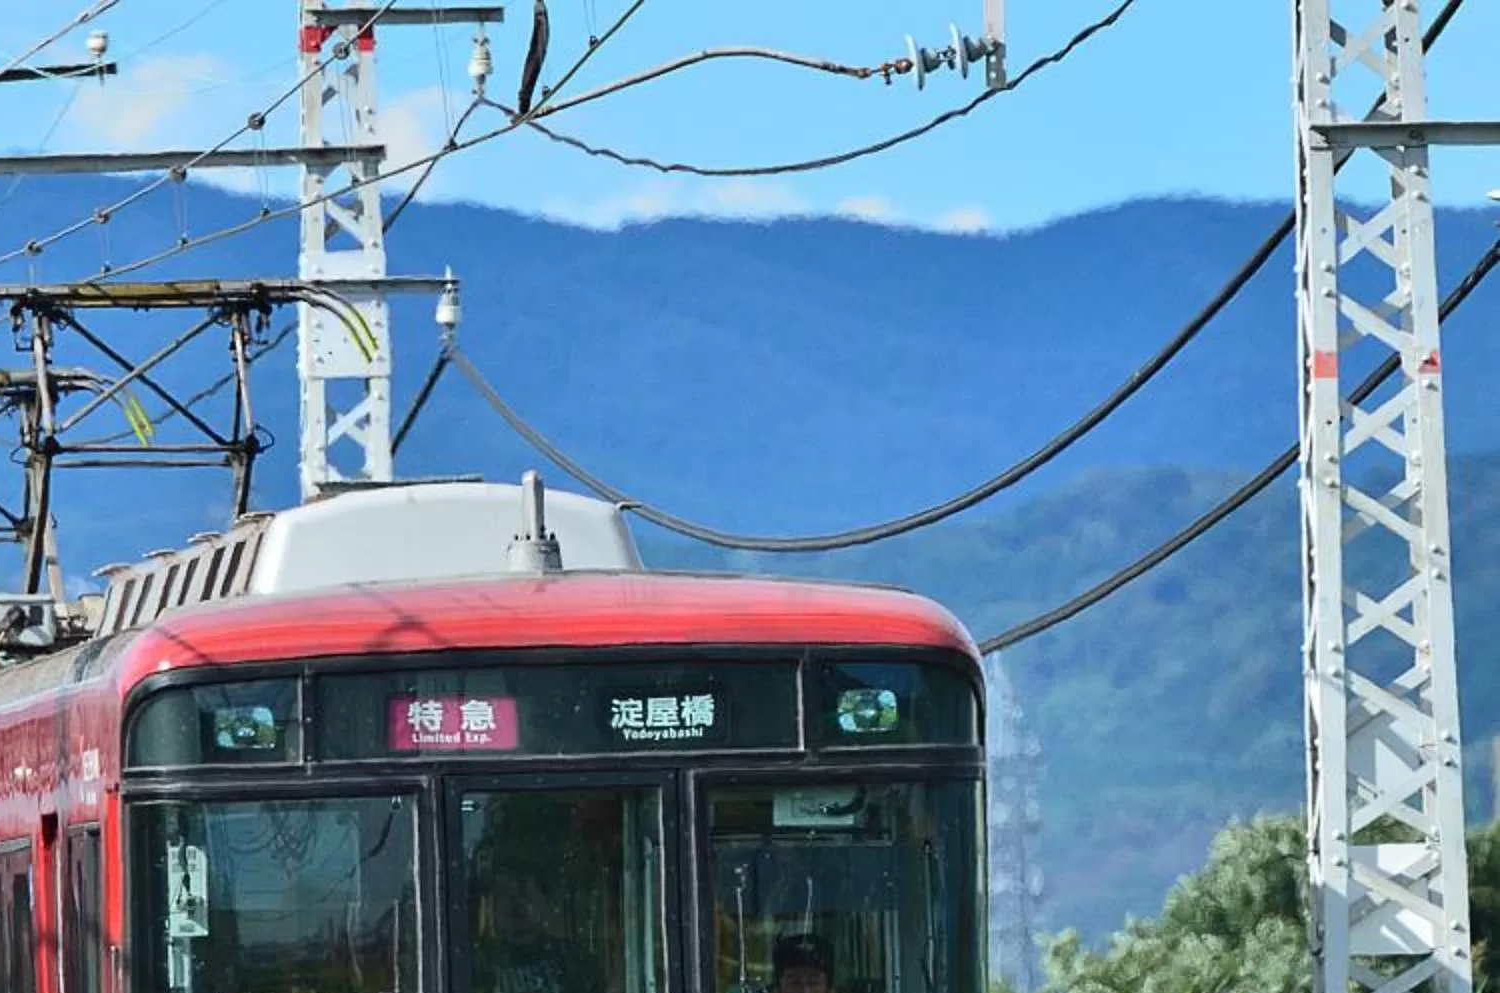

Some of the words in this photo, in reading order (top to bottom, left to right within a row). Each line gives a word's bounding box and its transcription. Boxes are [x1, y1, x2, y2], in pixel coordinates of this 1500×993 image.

[407, 700, 496, 731] 特急
[612, 694, 715, 728] 淀屋橋
[412, 732, 460, 743] Limited
[623, 727, 704, 741] Yodoyabashi
